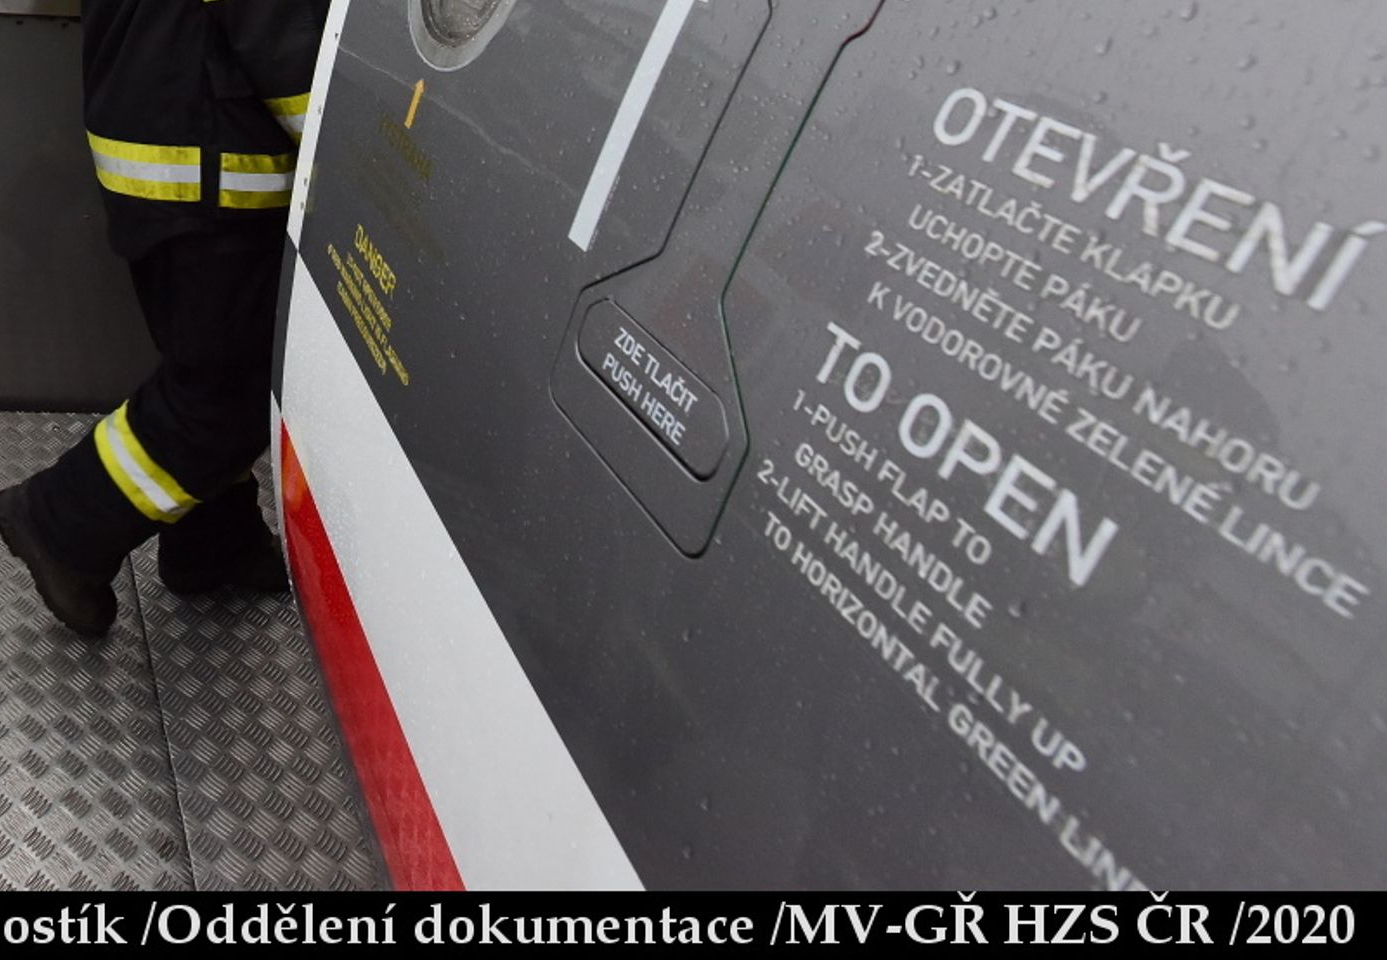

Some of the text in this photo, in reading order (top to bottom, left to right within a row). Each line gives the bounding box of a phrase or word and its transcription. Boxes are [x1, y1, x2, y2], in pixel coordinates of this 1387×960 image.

[908, 153, 1242, 331] 1-ZATLAČTE KLAPKU
[908, 203, 1145, 344] UCHOPTE PÁKU
[932, 87, 1387, 311] OTEVŘENÍ
[602, 352, 686, 446] PUSH HERE
[614, 327, 698, 414] ZDE TLAČIT
[816, 321, 1118, 587] TO OPEN
[864, 230, 1322, 512] 2-ZVEDNĚTE PÁKU NAHORU
[866, 281, 1372, 620] K VODOROVNÉ ZELENÉ LINCE
[792, 388, 993, 566] 1-PUSH FLAP TO
[794, 443, 993, 630] GRASP HANDLE
[757, 459, 1087, 773] 2-LIFT HANDLE FULLY UP
[763, 511, 792, 552] TO
[791, 545, 940, 713] HORIZONTAL
[947, 704, 1061, 825] GREEN
